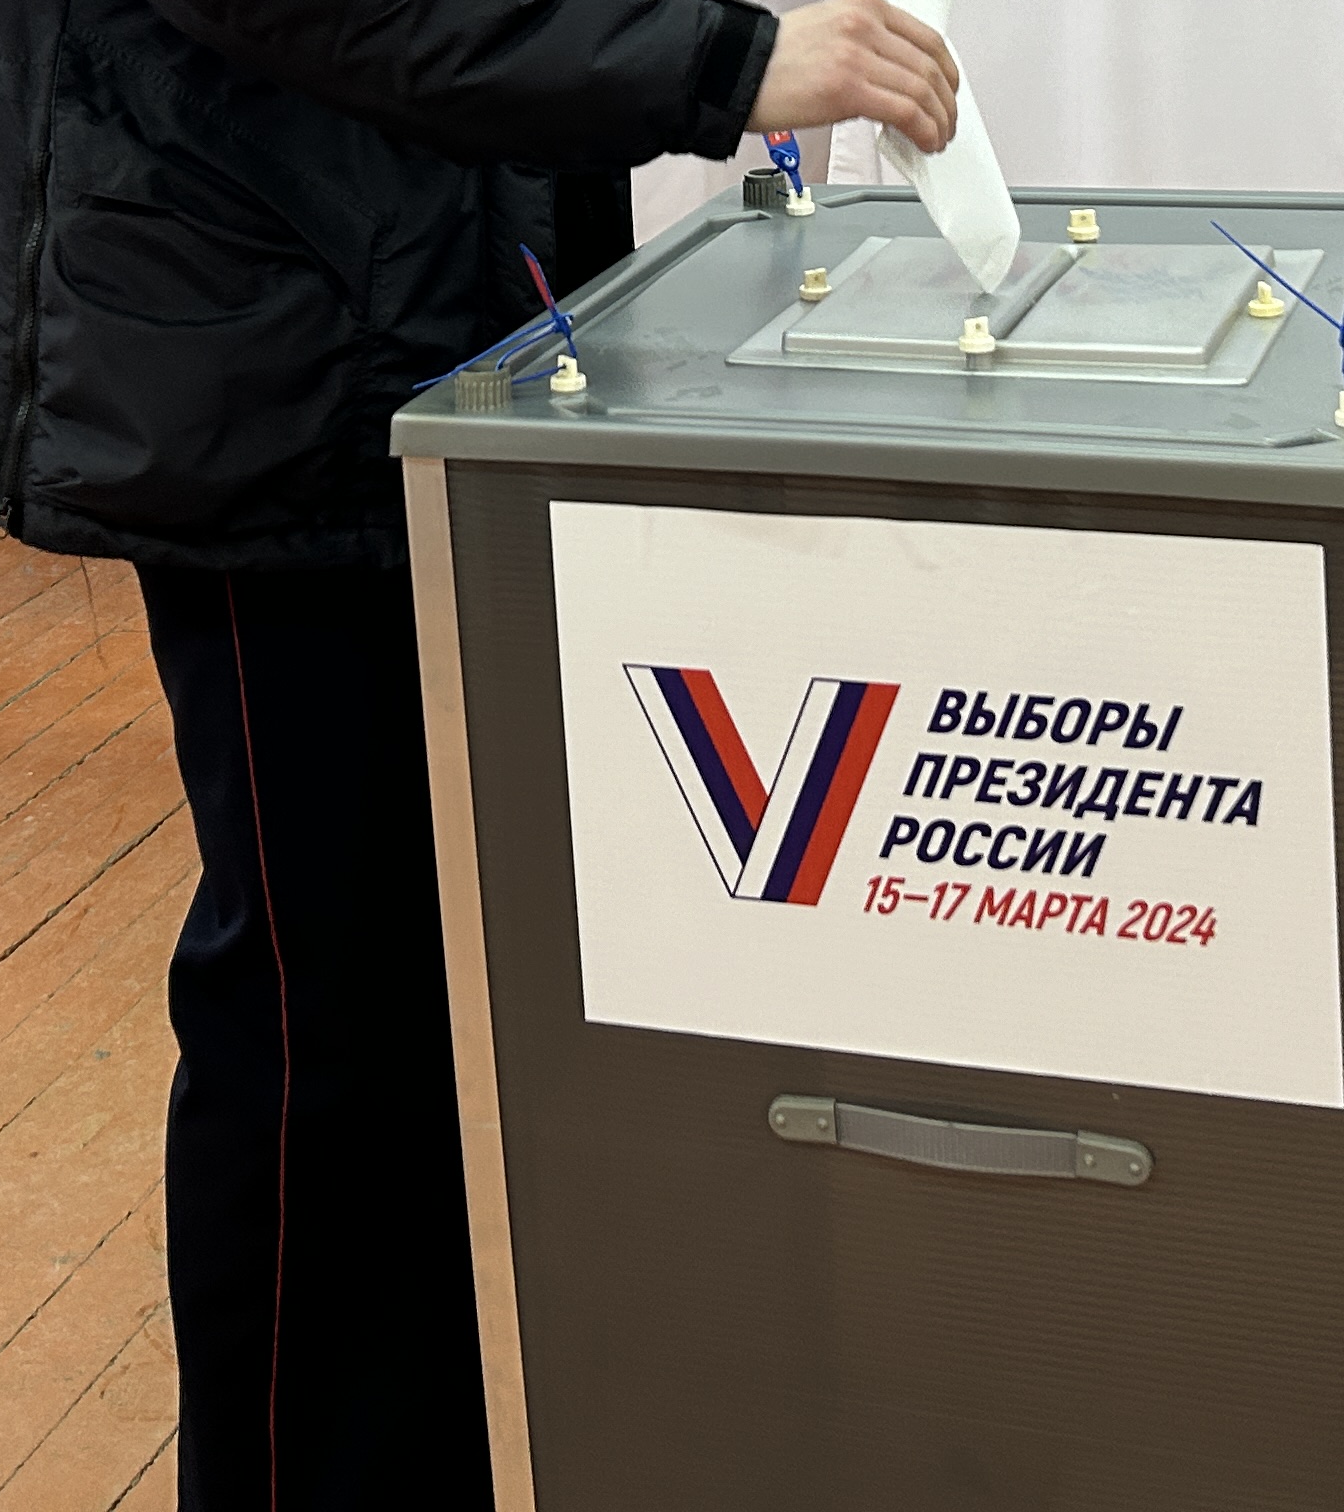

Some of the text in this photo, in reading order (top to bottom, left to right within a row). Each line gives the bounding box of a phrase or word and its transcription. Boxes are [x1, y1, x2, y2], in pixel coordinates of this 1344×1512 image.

[928, 688, 1183, 751] ВЫБОРЫ
[903, 752, 1264, 826] ПРЕЗИДЕНТА
[878, 817, 1107, 877] РОССИИ
[862, 874, 1217, 948] 15–17 МАРТА 2024
